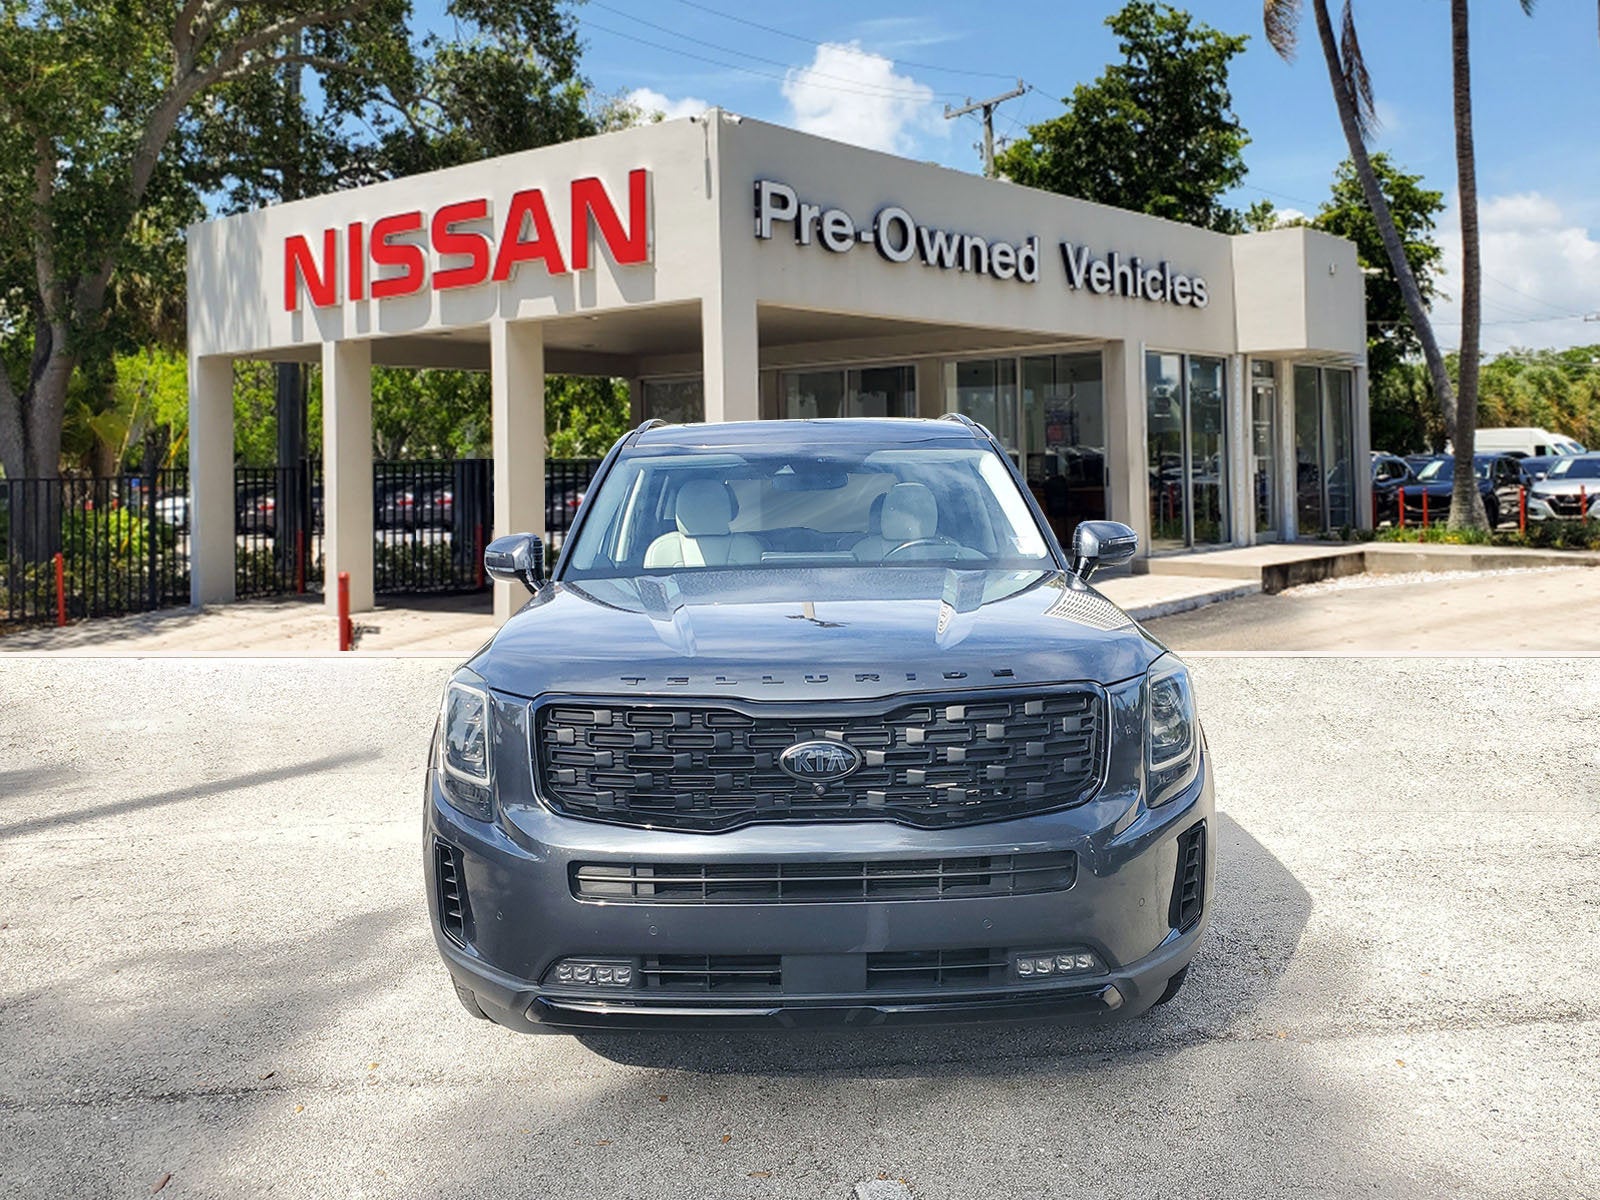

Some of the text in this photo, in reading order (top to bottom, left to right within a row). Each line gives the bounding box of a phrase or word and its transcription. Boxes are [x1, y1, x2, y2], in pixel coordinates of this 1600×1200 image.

[284, 168, 648, 312] NISSAN
[754, 180, 1209, 309] Pre-Owned Vehicles
[620, 668, 1016, 687] TELLURIDE
[793, 750, 848, 773] KIA
